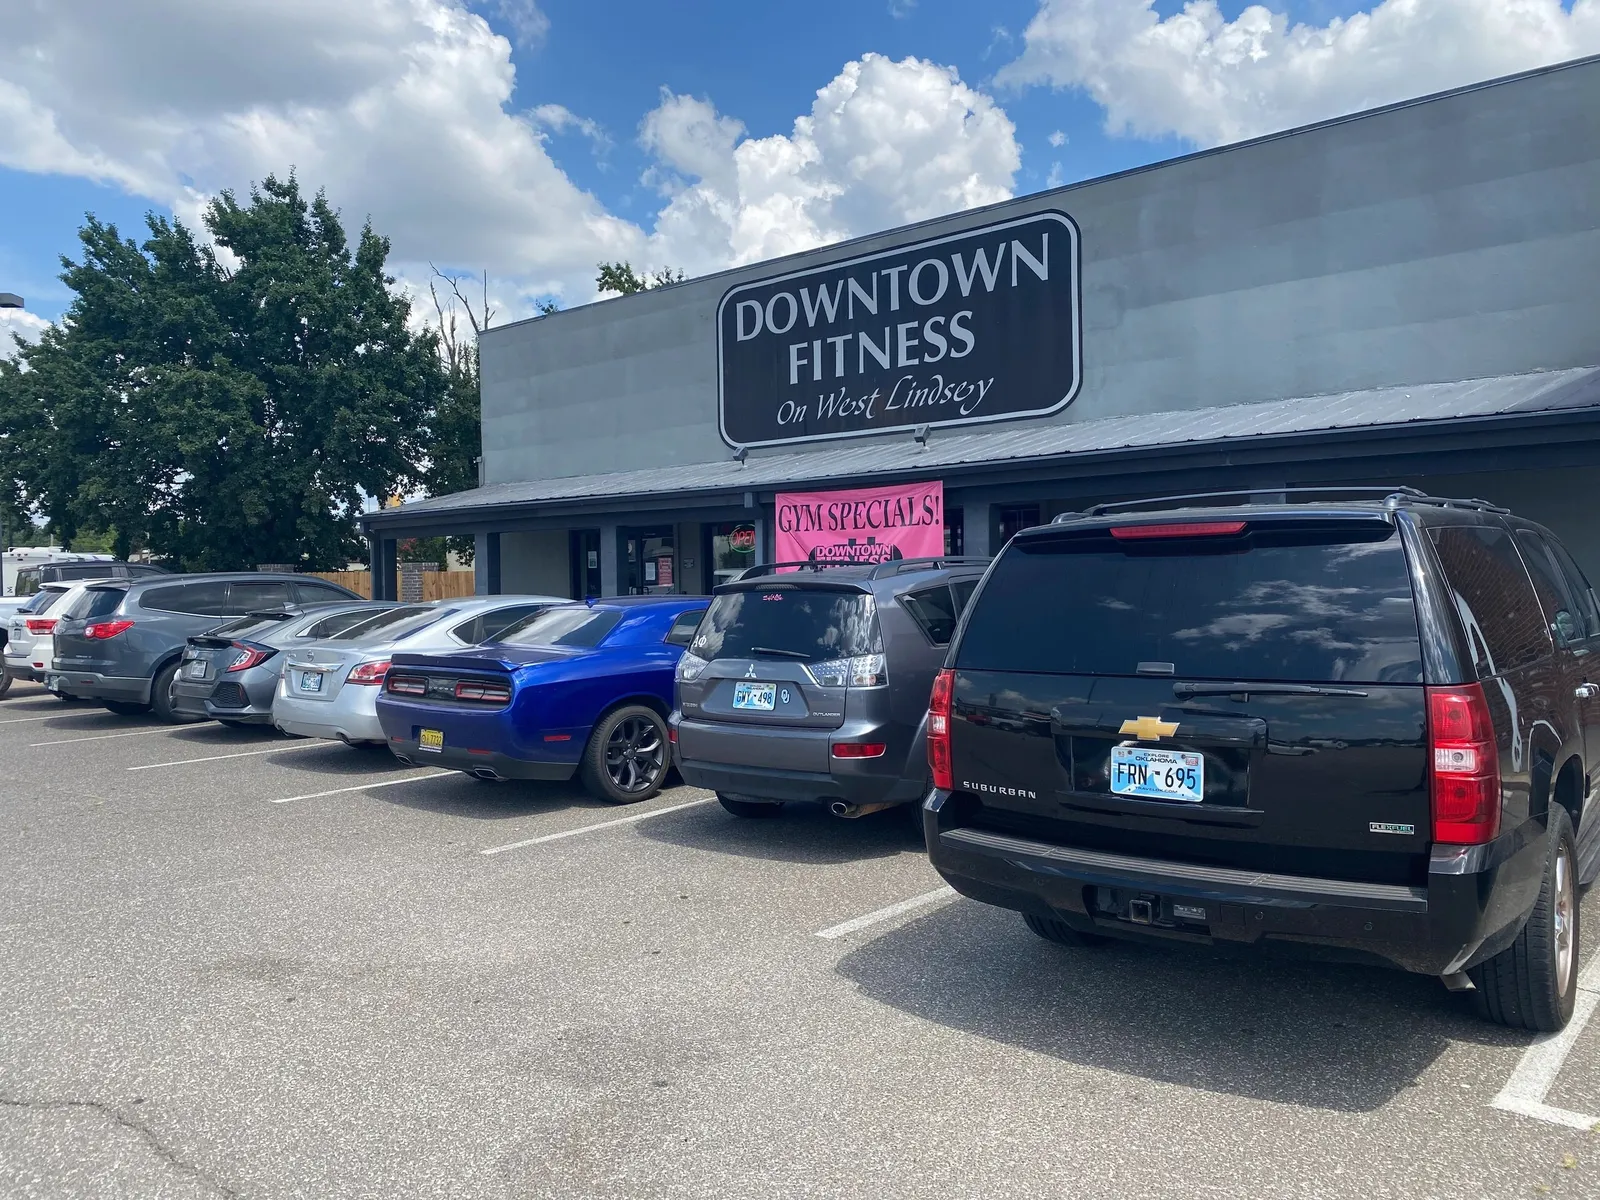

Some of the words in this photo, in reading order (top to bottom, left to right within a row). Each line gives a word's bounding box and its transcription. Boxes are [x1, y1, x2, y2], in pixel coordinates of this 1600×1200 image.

[736, 232, 1049, 342] DOWNTOWN
[789, 310, 975, 385] FITNESS
[776, 400, 806, 425] On
[816, 386, 882, 420] West
[884, 374, 995, 416] Lindsey
[778, 503, 824, 533] GYM
[828, 494, 940, 531] SPECIALS!
[816, 544, 891, 557] DOWNTOWN
[1135, 755, 1178, 764] OKLAHOMA
[963, 780, 1037, 800] SUBURBAN
